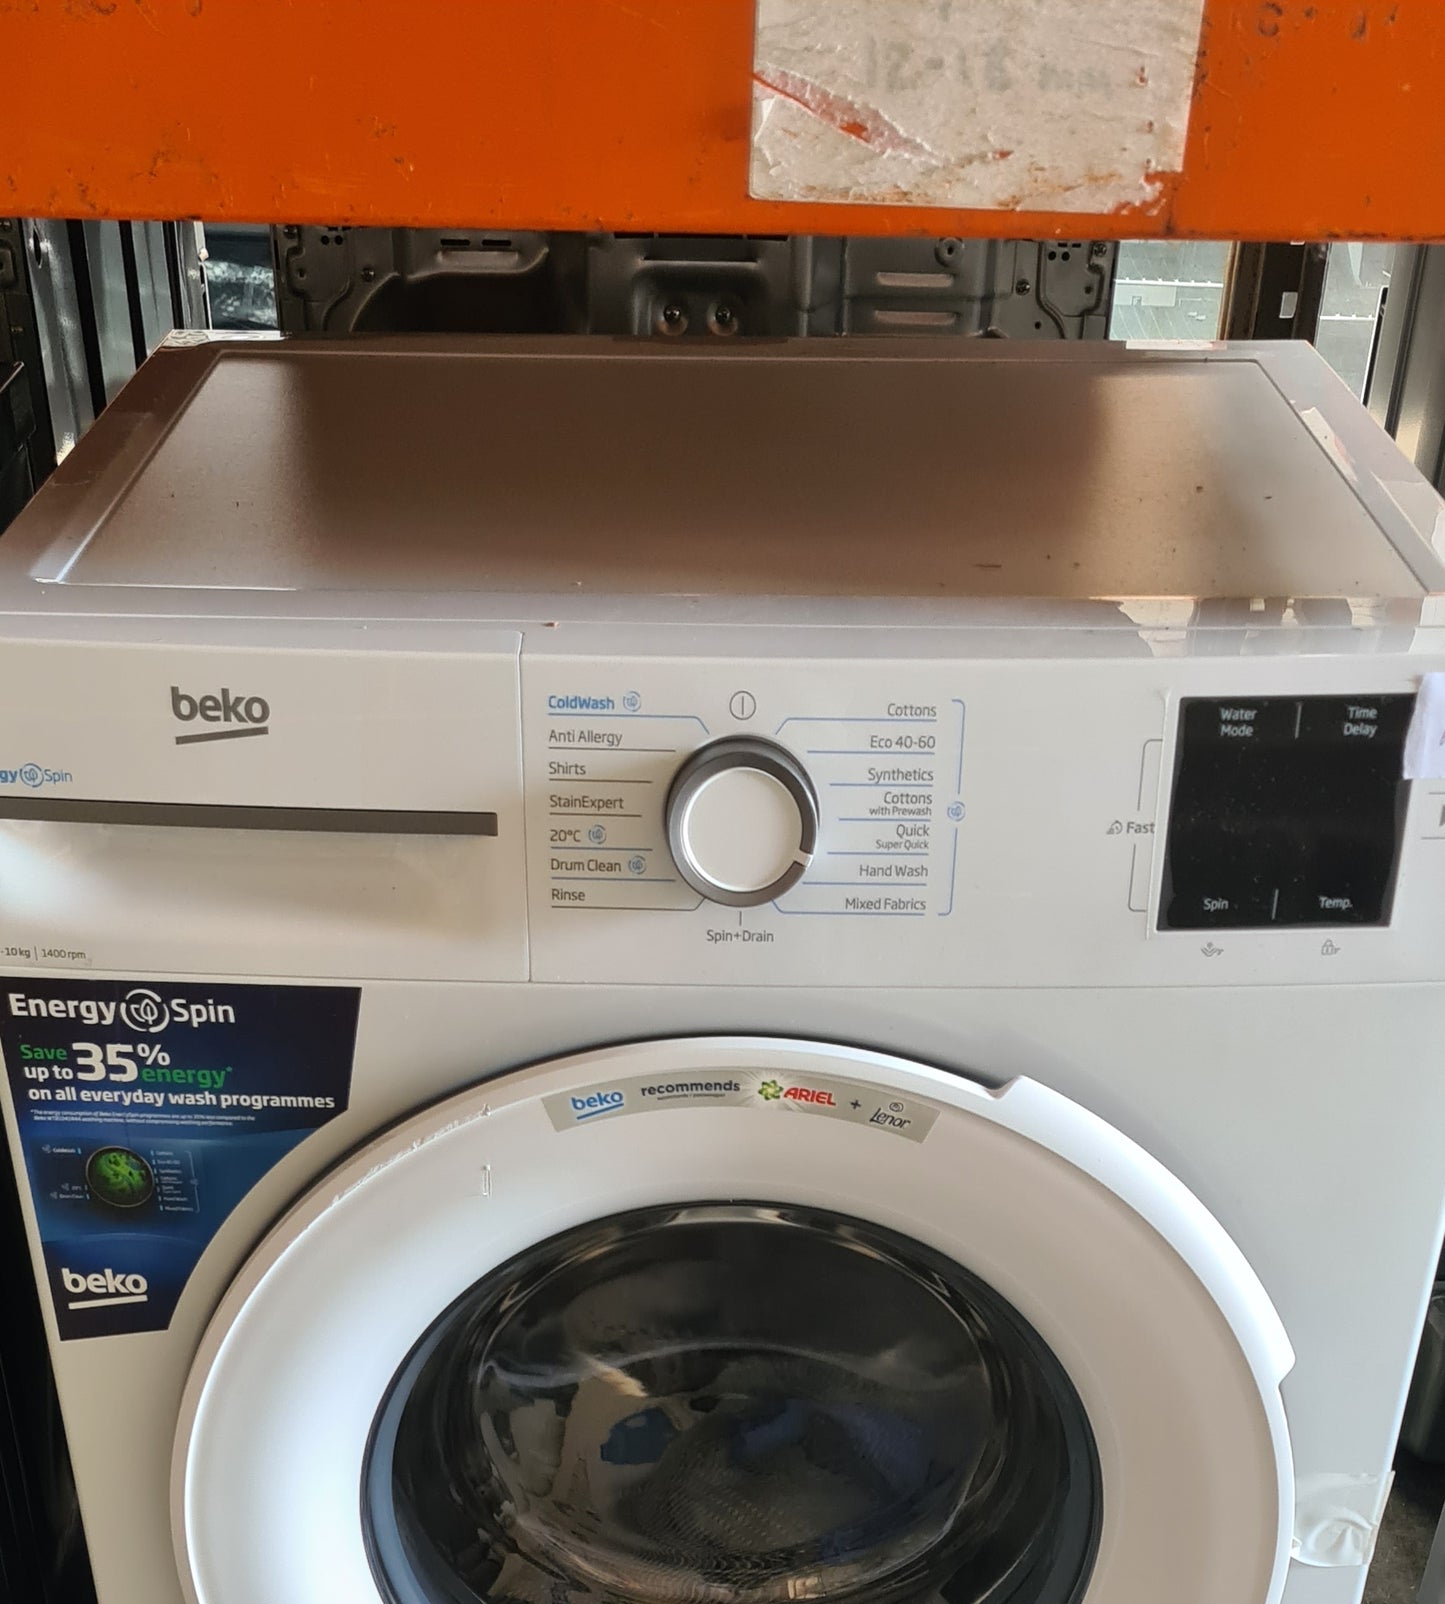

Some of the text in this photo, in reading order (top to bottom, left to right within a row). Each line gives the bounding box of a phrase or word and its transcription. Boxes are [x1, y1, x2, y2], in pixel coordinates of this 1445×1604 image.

[169, 686, 271, 724] beko
[548, 695, 615, 711] ColdWash
[887, 703, 937, 718] Cottons
[1220, 707, 1257, 721] Water
[1347, 706, 1377, 720] Time
[1220, 724, 1254, 737] Mode
[1343, 722, 1378, 739] Delay
[549, 730, 623, 747] Anti Allergy
[869, 735, 936, 750] Eco 40-60
[548, 761, 587, 776] Shirts
[867, 767, 934, 784] Synthetics
[43, 768, 74, 785] Spin
[549, 795, 624, 812] StainExpert
[883, 791, 933, 806] Cottons
[869, 806, 933, 817] with Prewash
[549, 829, 581, 844] 20°C
[895, 824, 931, 839] Quick
[875, 839, 930, 852] Super Quick
[550, 859, 622, 874] Drum Clean
[859, 863, 929, 878] Hand Wash
[551, 888, 586, 902] Rinse
[844, 897, 927, 911] Mixed Fabrics
[1203, 897, 1229, 912] Spin
[1318, 896, 1354, 911] Temp.
[8, 993, 236, 1027] Energy Spin
[19, 1043, 68, 1061] Save
[71, 1041, 171, 1083] 35%
[24, 1065, 74, 1083] up to
[28, 1086, 336, 1109] on all everyday wash programmes
[571, 1091, 624, 1111] beko
[640, 1079, 741, 1097] recommends
[783, 1086, 837, 1106] ARIEL
[869, 1107, 912, 1130] Lenor
[61, 1267, 148, 1295] beko
